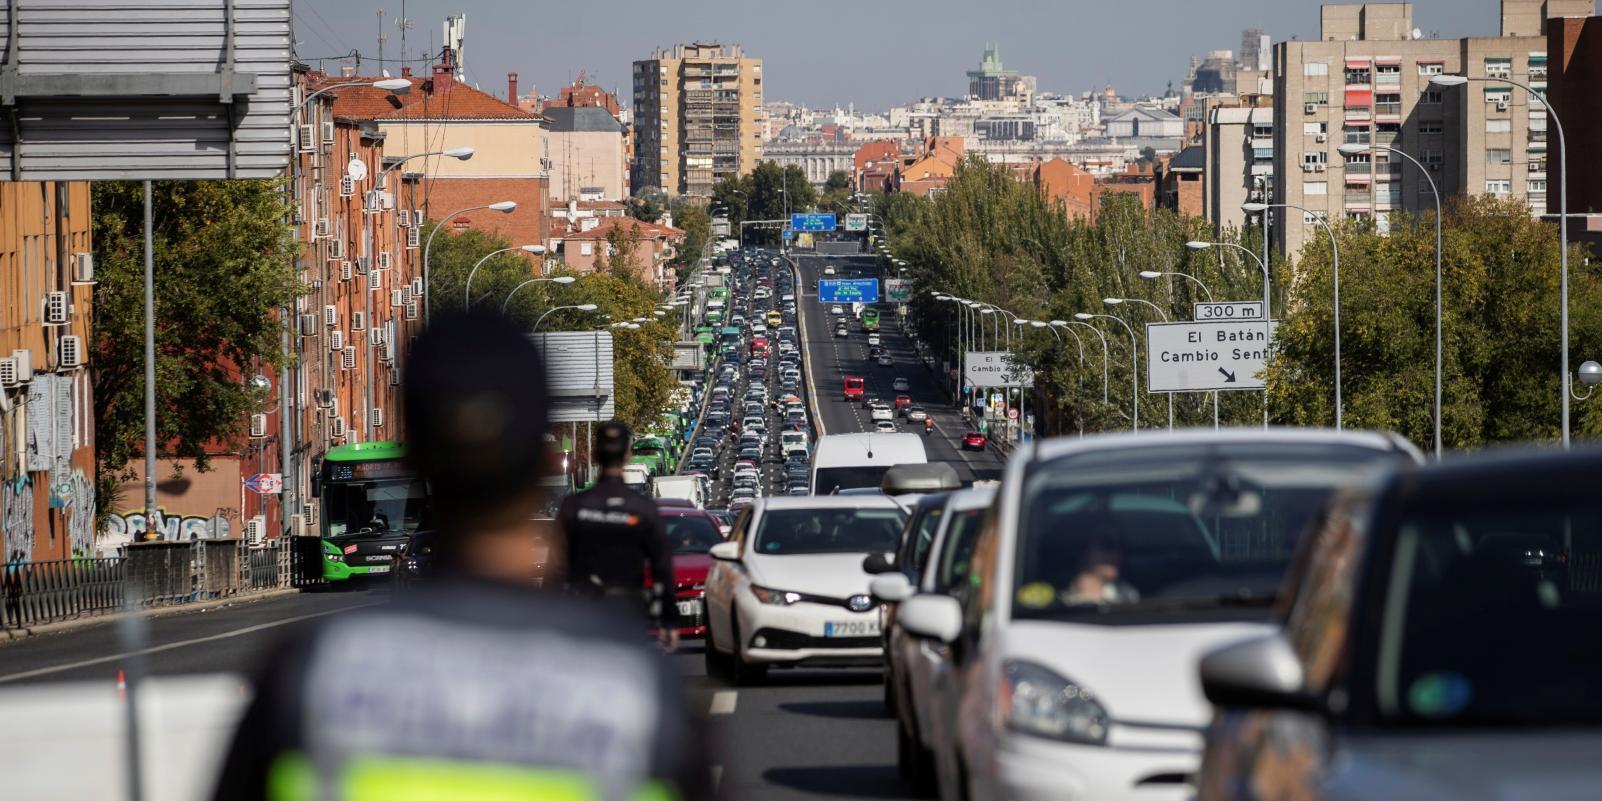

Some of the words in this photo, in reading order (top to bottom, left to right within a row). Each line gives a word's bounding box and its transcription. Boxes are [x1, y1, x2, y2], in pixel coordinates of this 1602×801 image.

[1204, 306, 1234, 317] 300
[1242, 307, 1255, 316] m
[1188, 331, 1202, 343] El
[1217, 329, 1265, 341] Batán
[1161, 350, 1218, 362] Cambio
[1232, 348, 1269, 360] Sent
[835, 622, 865, 634] 7700
